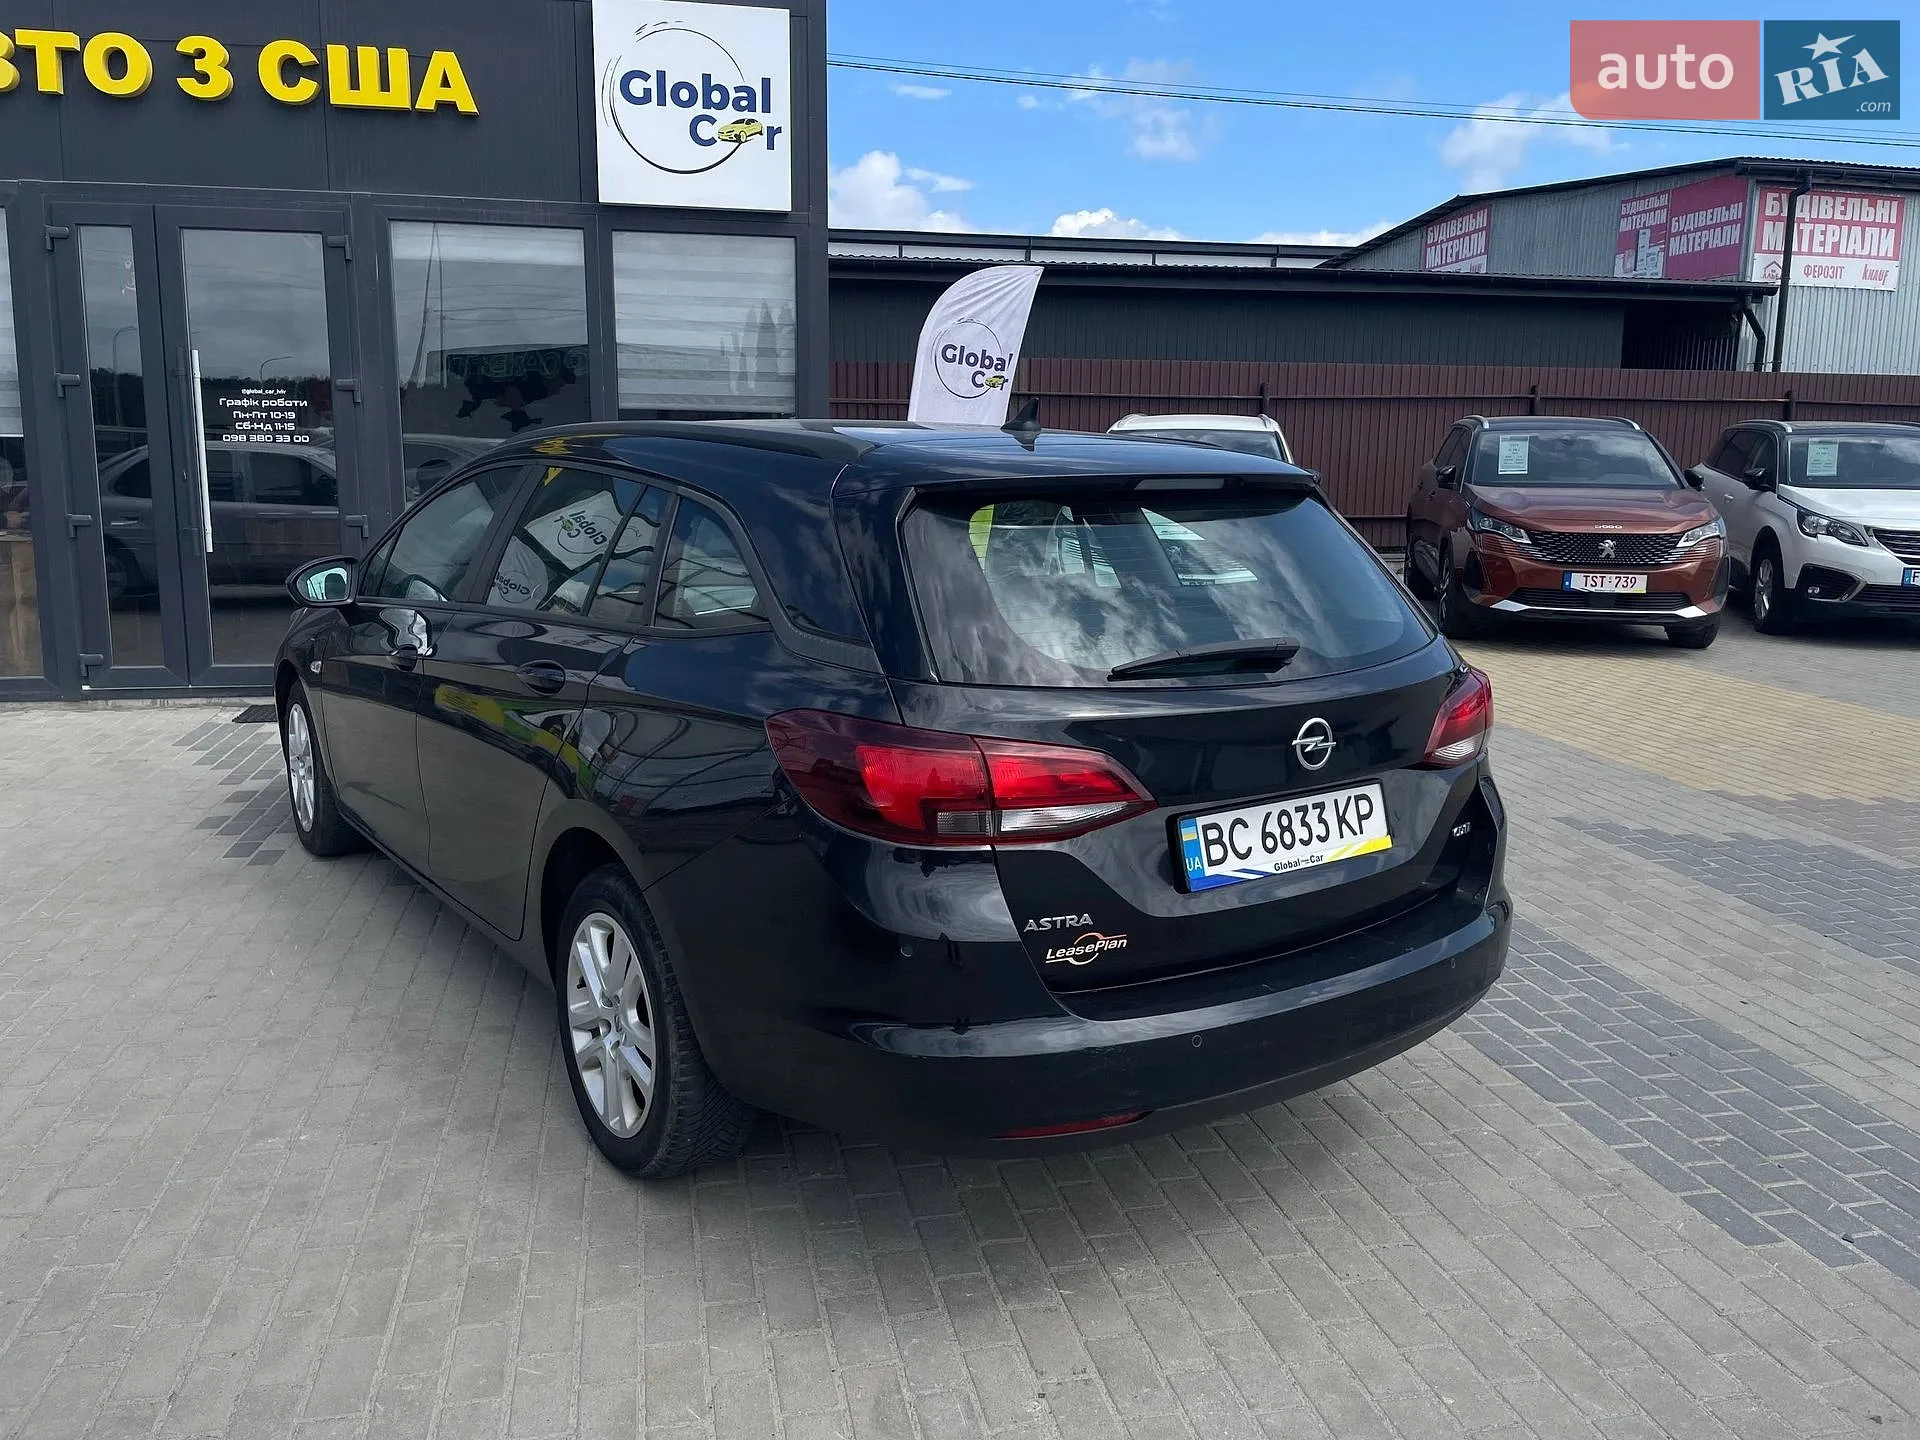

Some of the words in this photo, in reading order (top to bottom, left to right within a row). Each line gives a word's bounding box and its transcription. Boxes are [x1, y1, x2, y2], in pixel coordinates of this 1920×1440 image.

[258, 40, 479, 115] США
[619, 69, 772, 114] Global
[1621, 193, 1668, 215] БУДІВЕЛЬНІ
[1427, 208, 1488, 245] БУДІВЕЛЬНІ
[1620, 208, 1667, 232] МАТЕРІАЛИ
[1671, 202, 1743, 233] БУДІВЕЛЬНІ
[1426, 230, 1486, 268] МАТЕРІАЛИ
[1669, 223, 1741, 257] МАТЕРІАЛИ
[1803, 263, 1845, 279] ФЕРОЗІТ
[219, 398, 260, 408] Графік
[261, 398, 308, 408] роботи
[233, 410, 268, 419] Пн-Пт
[269, 411, 296, 419] 10-19
[235, 421, 273, 431] Сб-Нд
[274, 422, 296, 430] 11-15
[222, 434, 247, 442] 098
[249, 434, 273, 442] 380
[275, 435, 291, 443] 33
[293, 435, 310, 443] 00
[1201, 817, 1253, 868] BC
[1261, 801, 1331, 854] 6833
[1334, 793, 1374, 839] KP
[1186, 856, 1202, 872] UA
[1273, 858, 1301, 872] Global
[1309, 854, 1324, 864] Car
[1023, 913, 1094, 933] ASTRA
[1046, 939, 1128, 960] LeasePlan
